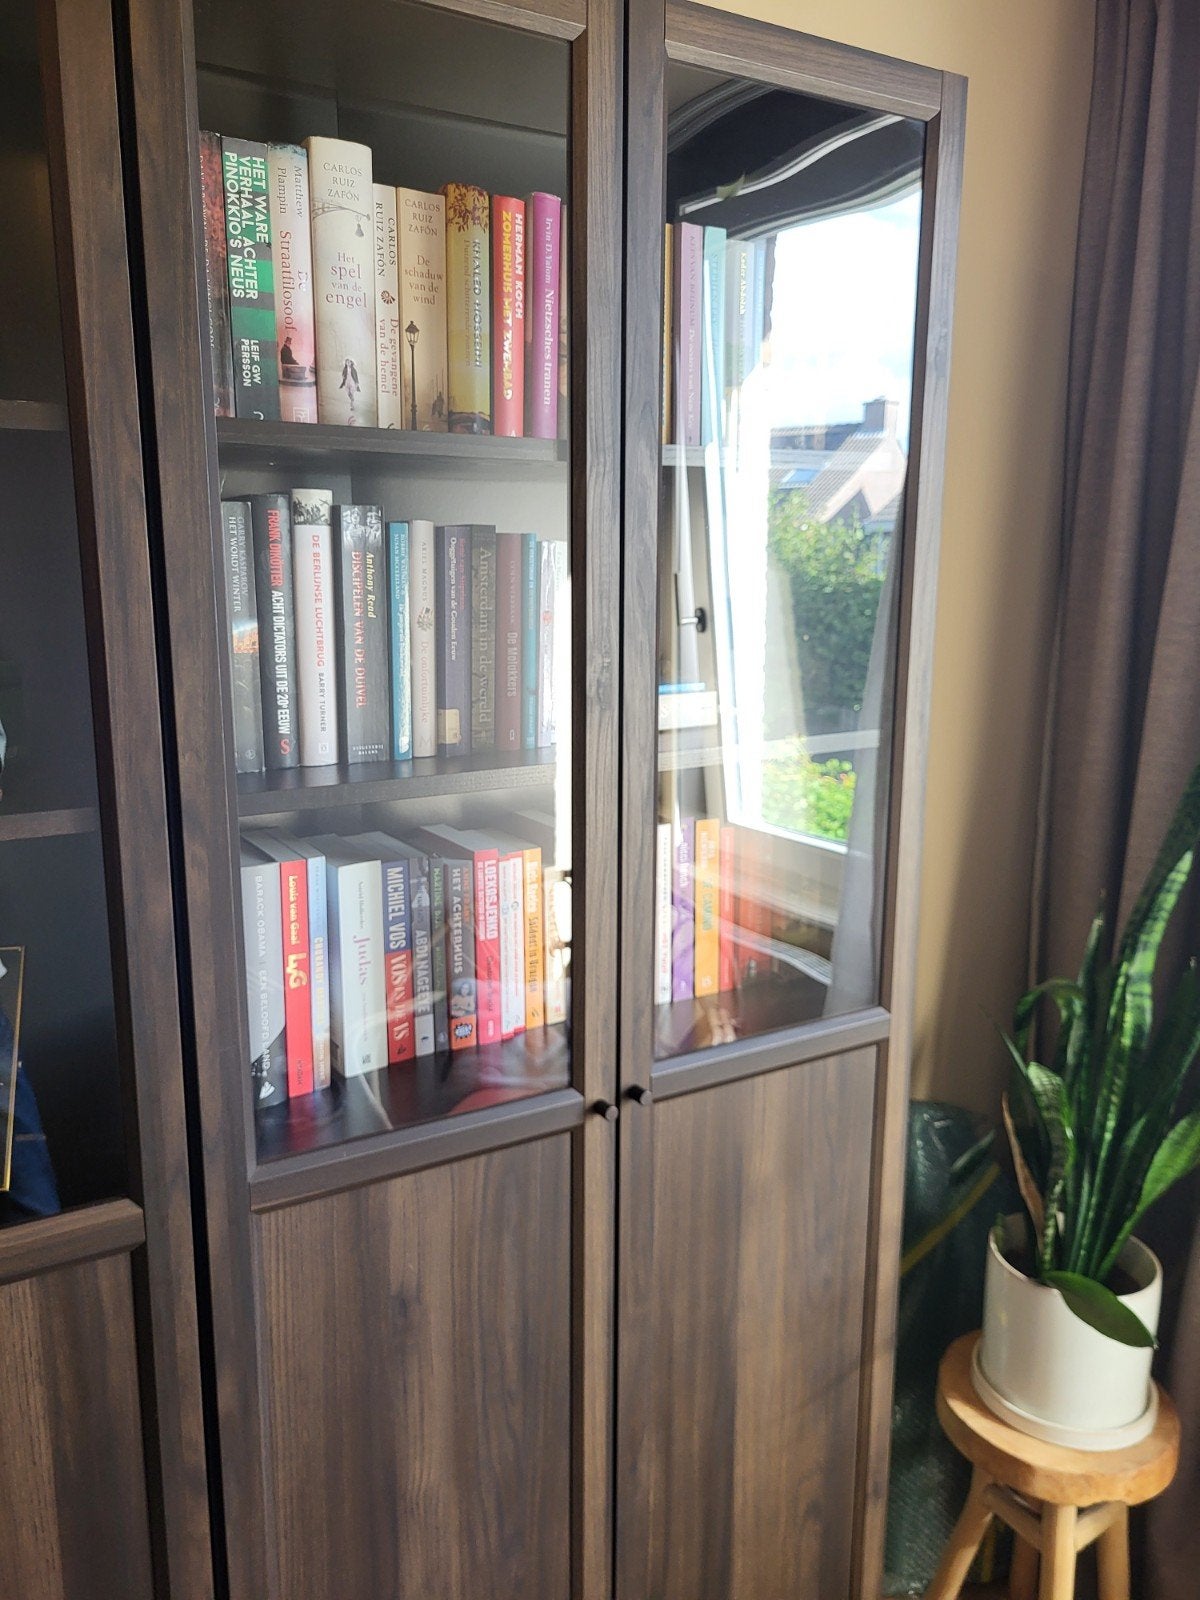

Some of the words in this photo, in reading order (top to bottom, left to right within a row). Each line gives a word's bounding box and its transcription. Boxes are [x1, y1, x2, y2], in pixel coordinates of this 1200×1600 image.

[252, 156, 266, 189] HET
[323, 161, 363, 177] CARLOS
[332, 177, 355, 188] RUIZ
[225, 152, 242, 249] PINOKKIO'S
[239, 156, 254, 228] VERHAAL
[277, 167, 287, 214] Plampin
[294, 165, 303, 218] Matthew
[327, 188, 360, 202] ZAFÓN
[404, 198, 440, 212] CARLOS
[254, 196, 269, 243] WARE
[375, 202, 384, 232] RUIZ
[408, 224, 438, 236] ZAFÓN
[412, 214, 433, 223] RUIZ
[545, 217, 553, 241] Irvin
[337, 252, 355, 263] Het
[377, 236, 386, 278] ZAFÓN
[388, 217, 396, 266] CARLOS
[503, 210, 512, 293] ZOMERHUIS
[515, 213, 523, 275] HERMAN
[230, 254, 245, 299] NEUS
[243, 236, 258, 300] ACHTER
[331, 263, 361, 281] spel
[404, 267, 443, 280] schaduw
[417, 255, 430, 266] De
[473, 239, 482, 296] KHALED
[279, 230, 297, 332] Straatfilosoof
[331, 281, 349, 290] van
[351, 281, 362, 292] de
[409, 282, 426, 291] van
[428, 282, 439, 293] de
[326, 292, 367, 310] engel
[413, 294, 436, 305] wind
[503, 298, 512, 327] MET
[515, 280, 523, 318] KOCH
[390, 318, 399, 334] De
[474, 299, 482, 368] HOSSEINI
[544, 289, 555, 360] Nietzsches
[241, 338, 251, 387] PERSSON
[250, 339, 260, 362] LEIF
[380, 343, 389, 356] de
[503, 330, 513, 400] ZWEMBAD
[251, 365, 261, 384] GW
[381, 360, 390, 394] hemel
[389, 339, 398, 397] gevangene
[544, 362, 552, 405] tranen
[229, 516, 237, 534] HET
[267, 509, 280, 541] FRANK
[230, 537, 239, 573] WORDT
[312, 534, 320, 549] DE
[366, 551, 376, 591] Anthony
[448, 537, 457, 585] Ooggetuigen
[232, 575, 241, 613] WINTER
[312, 552, 323, 604] BERLIJNSE
[351, 550, 364, 617] DISCIPELEN
[480, 547, 493, 632] Amsterdam
[271, 590, 285, 614] ACHT
[367, 595, 377, 619] Read
[450, 600, 457, 609] de
[273, 616, 287, 663] DICTATORS
[315, 607, 325, 668] LUCHTBRUG
[353, 620, 365, 645] VAN
[450, 610, 458, 640] Gouden
[507, 632, 518, 645] De
[354, 648, 365, 664] DE
[421, 641, 428, 654] De
[480, 637, 489, 652] in
[275, 665, 288, 679] UIT
[480, 655, 492, 672] de
[507, 647, 518, 697] Molukkers
[276, 681, 288, 693] DE
[318, 672, 327, 698] BARRY
[355, 667, 366, 709] DUIVEL
[480, 675, 492, 723] wereld
[278, 709, 291, 735] EEUW
[319, 700, 327, 733] TURNER
[288, 875, 298, 902] Louis
[387, 866, 405, 921] MICHIEL
[452, 868, 461, 891] HET
[255, 875, 264, 917] BARACK
[484, 860, 498, 939] LOEKASJENKO
[289, 903, 298, 922] van
[257, 919, 266, 957] OBAMA
[290, 922, 300, 946] Gaal
[389, 922, 406, 949] VOS
[415, 929, 428, 958] ABDI
[453, 896, 463, 974] ACHTERHUIS
[353, 934, 371, 986] Judas
[390, 953, 408, 986] VOS
[415, 960, 430, 1013] NAGEEYE
